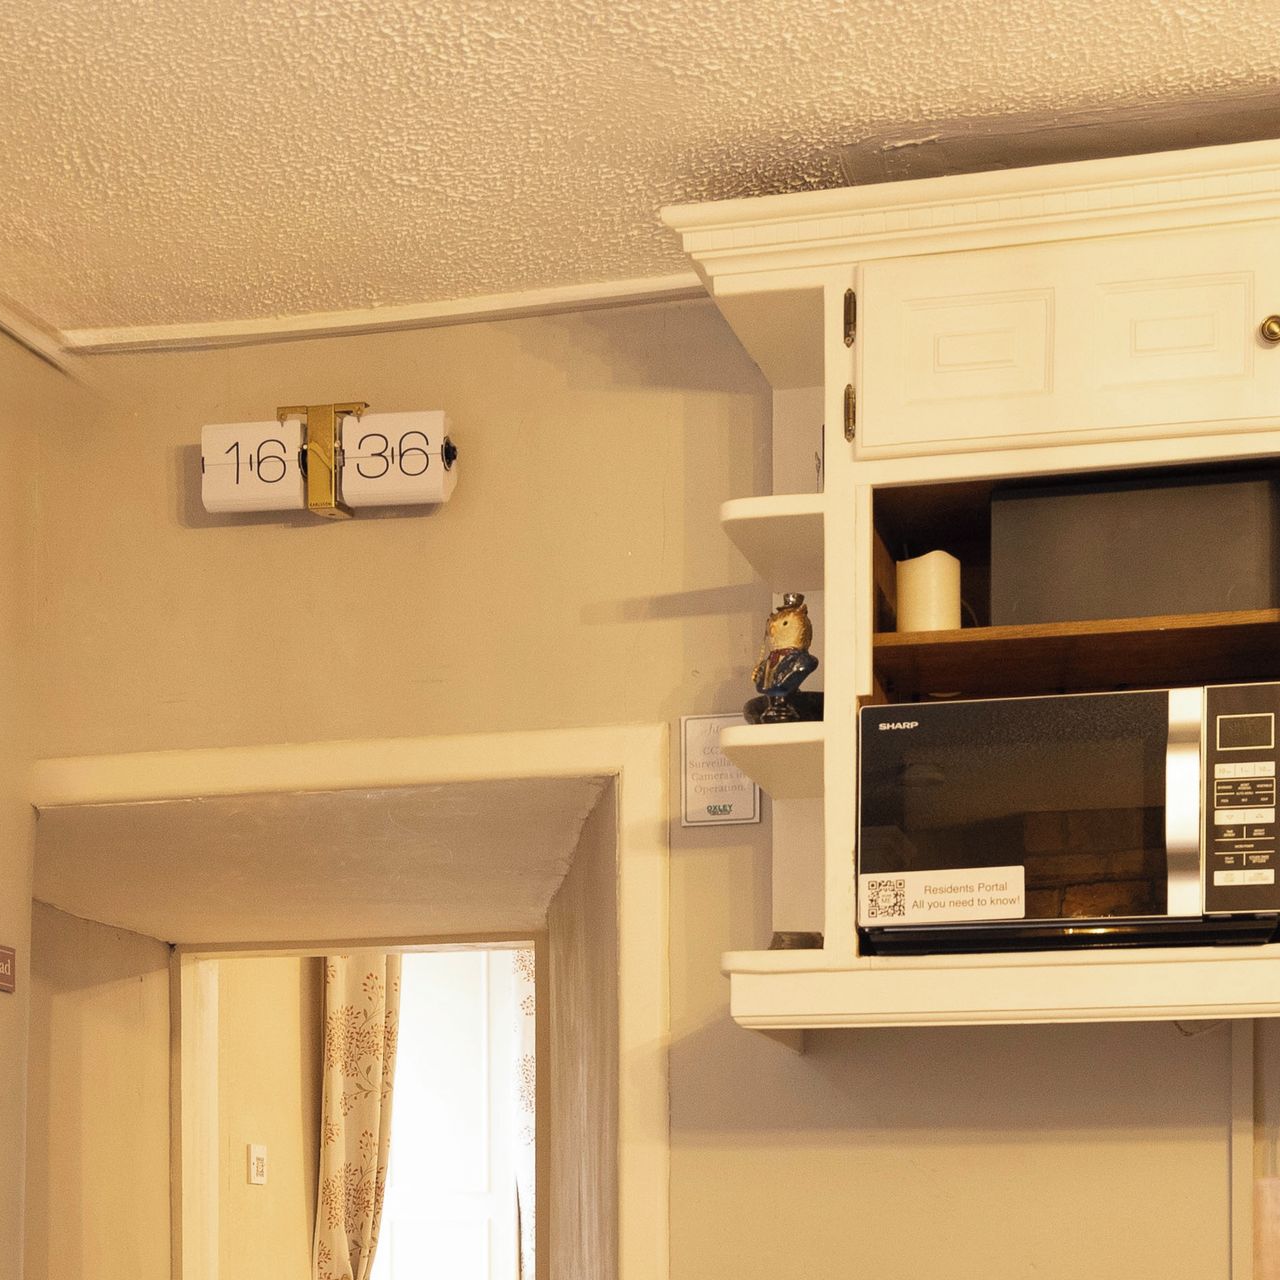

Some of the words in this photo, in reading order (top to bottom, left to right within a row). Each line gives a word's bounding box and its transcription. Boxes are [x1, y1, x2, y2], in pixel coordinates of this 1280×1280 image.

[878, 721, 919, 731] SHARP
[691, 771, 736, 781] Cameras
[924, 882, 975, 895] Residents
[977, 881, 1008, 893] Portal
[911, 899, 925, 909] All
[927, 900, 946, 912] you
[949, 897, 975, 908] need
[977, 898, 987, 907] to
[989, 895, 1021, 906] know!
